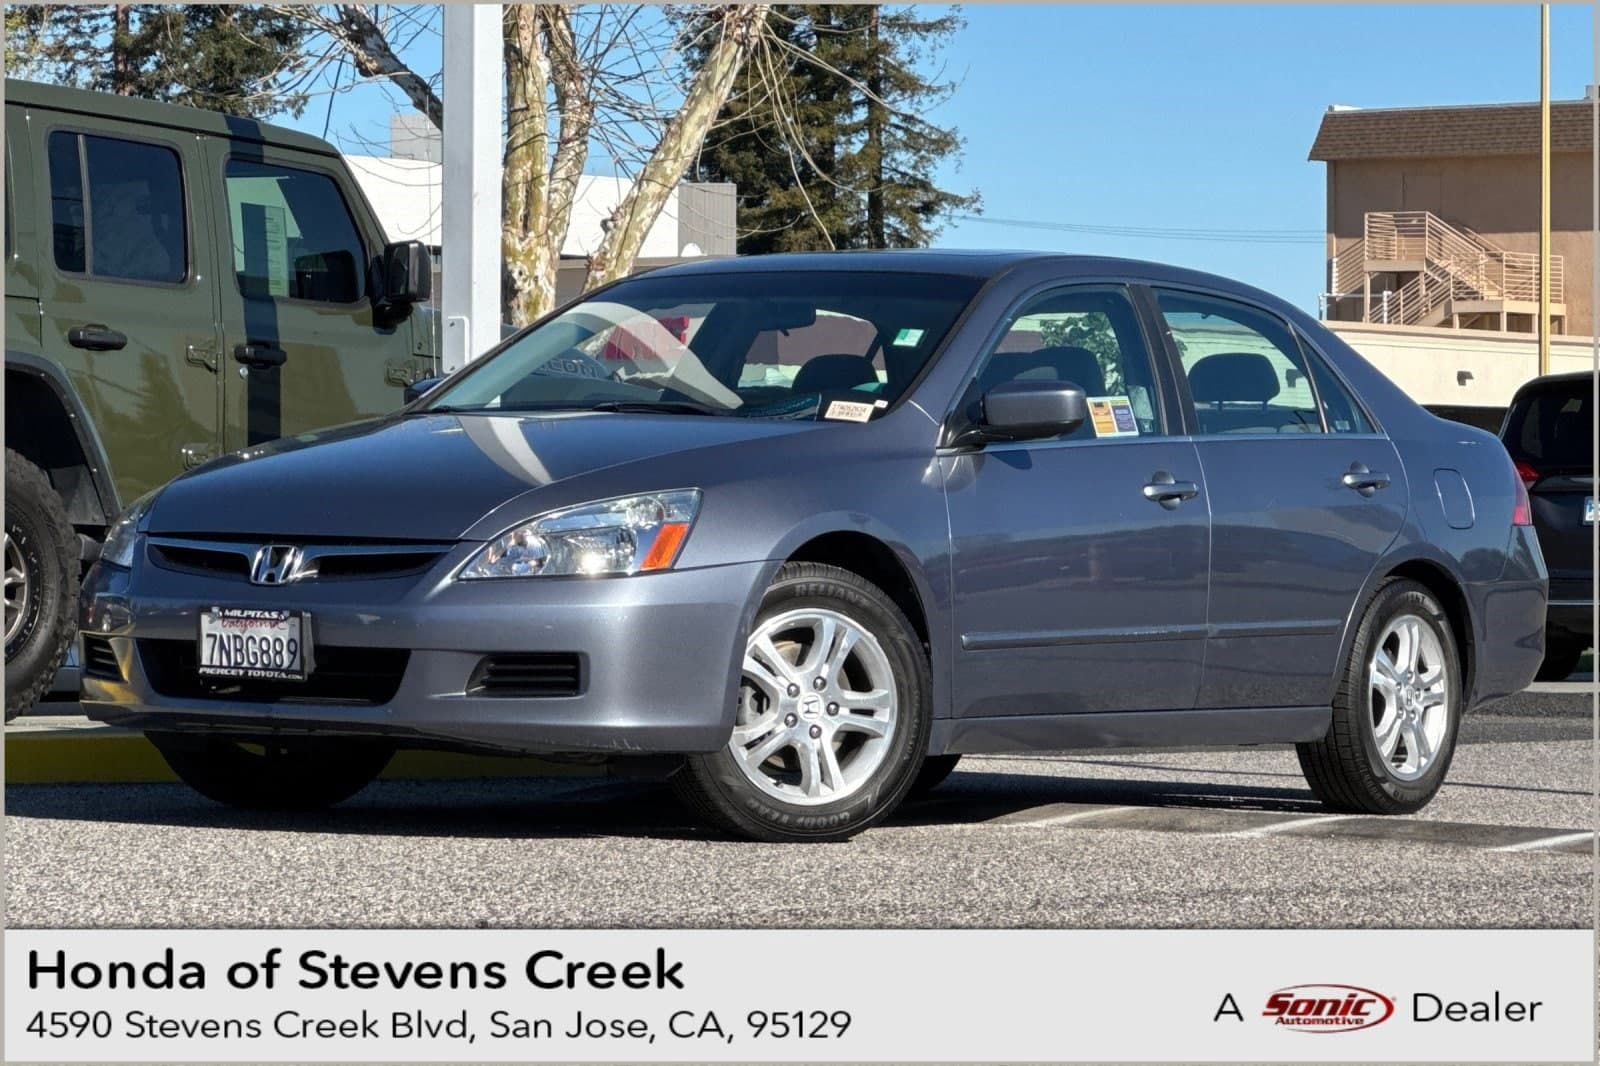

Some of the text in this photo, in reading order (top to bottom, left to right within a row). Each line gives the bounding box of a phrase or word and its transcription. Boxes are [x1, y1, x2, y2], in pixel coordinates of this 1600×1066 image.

[224, 608, 280, 619] MILPITAS
[206, 632, 298, 670] 7NBG889
[199, 667, 244, 677] PIERCEY
